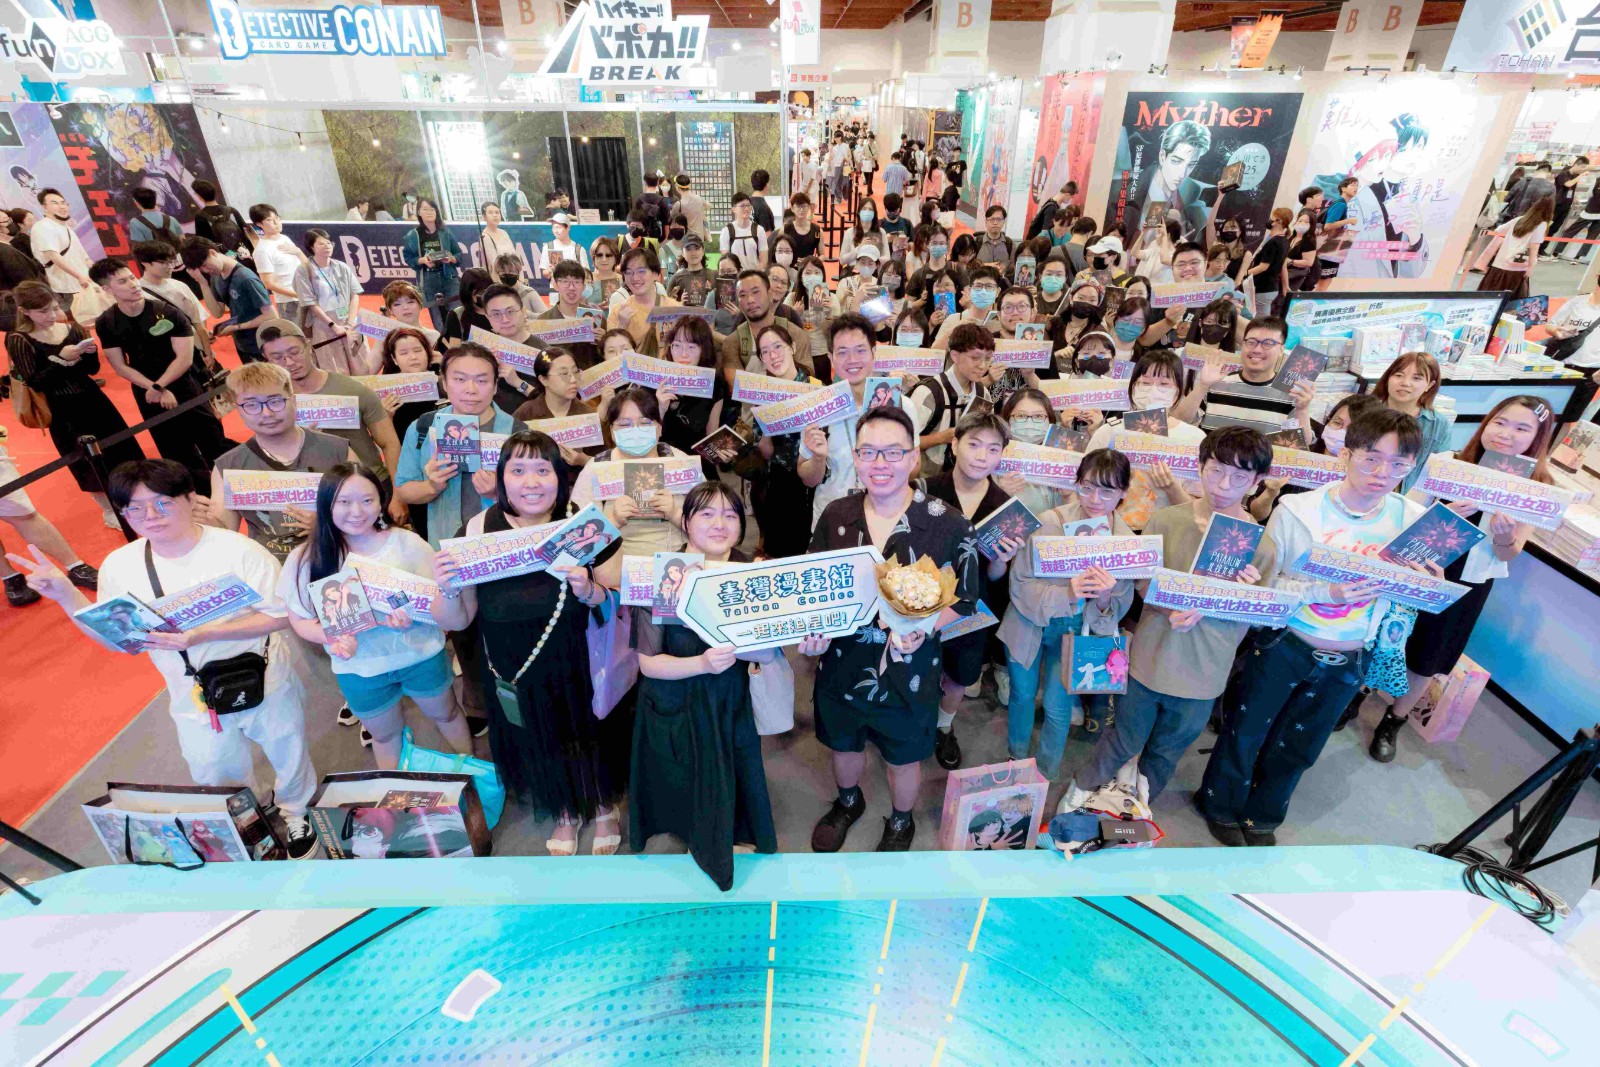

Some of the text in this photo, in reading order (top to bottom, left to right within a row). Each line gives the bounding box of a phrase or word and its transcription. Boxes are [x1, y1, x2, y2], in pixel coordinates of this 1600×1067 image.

[957, 2, 973, 28] B
[214, 2, 333, 58] DETECTIVE
[334, 8, 445, 54] CONAN
[260, 41, 290, 49] CARD
[589, 65, 682, 81] BREAK
[1134, 99, 1273, 131] Myther
[1423, 478, 1560, 515] 我超沉迷《北投女巫》
[1040, 550, 1159, 573] 我超沉迷《北投女巫》
[717, 563, 855, 607] 臺灣漫畫館
[1301, 562, 1450, 603] 我超沉迷北投女巫》
[797, 590, 855, 605] Comics
[1155, 592, 1290, 616] 我超沉迷《北投女巫》
[736, 611, 847, 640] 一起來追星吧!
